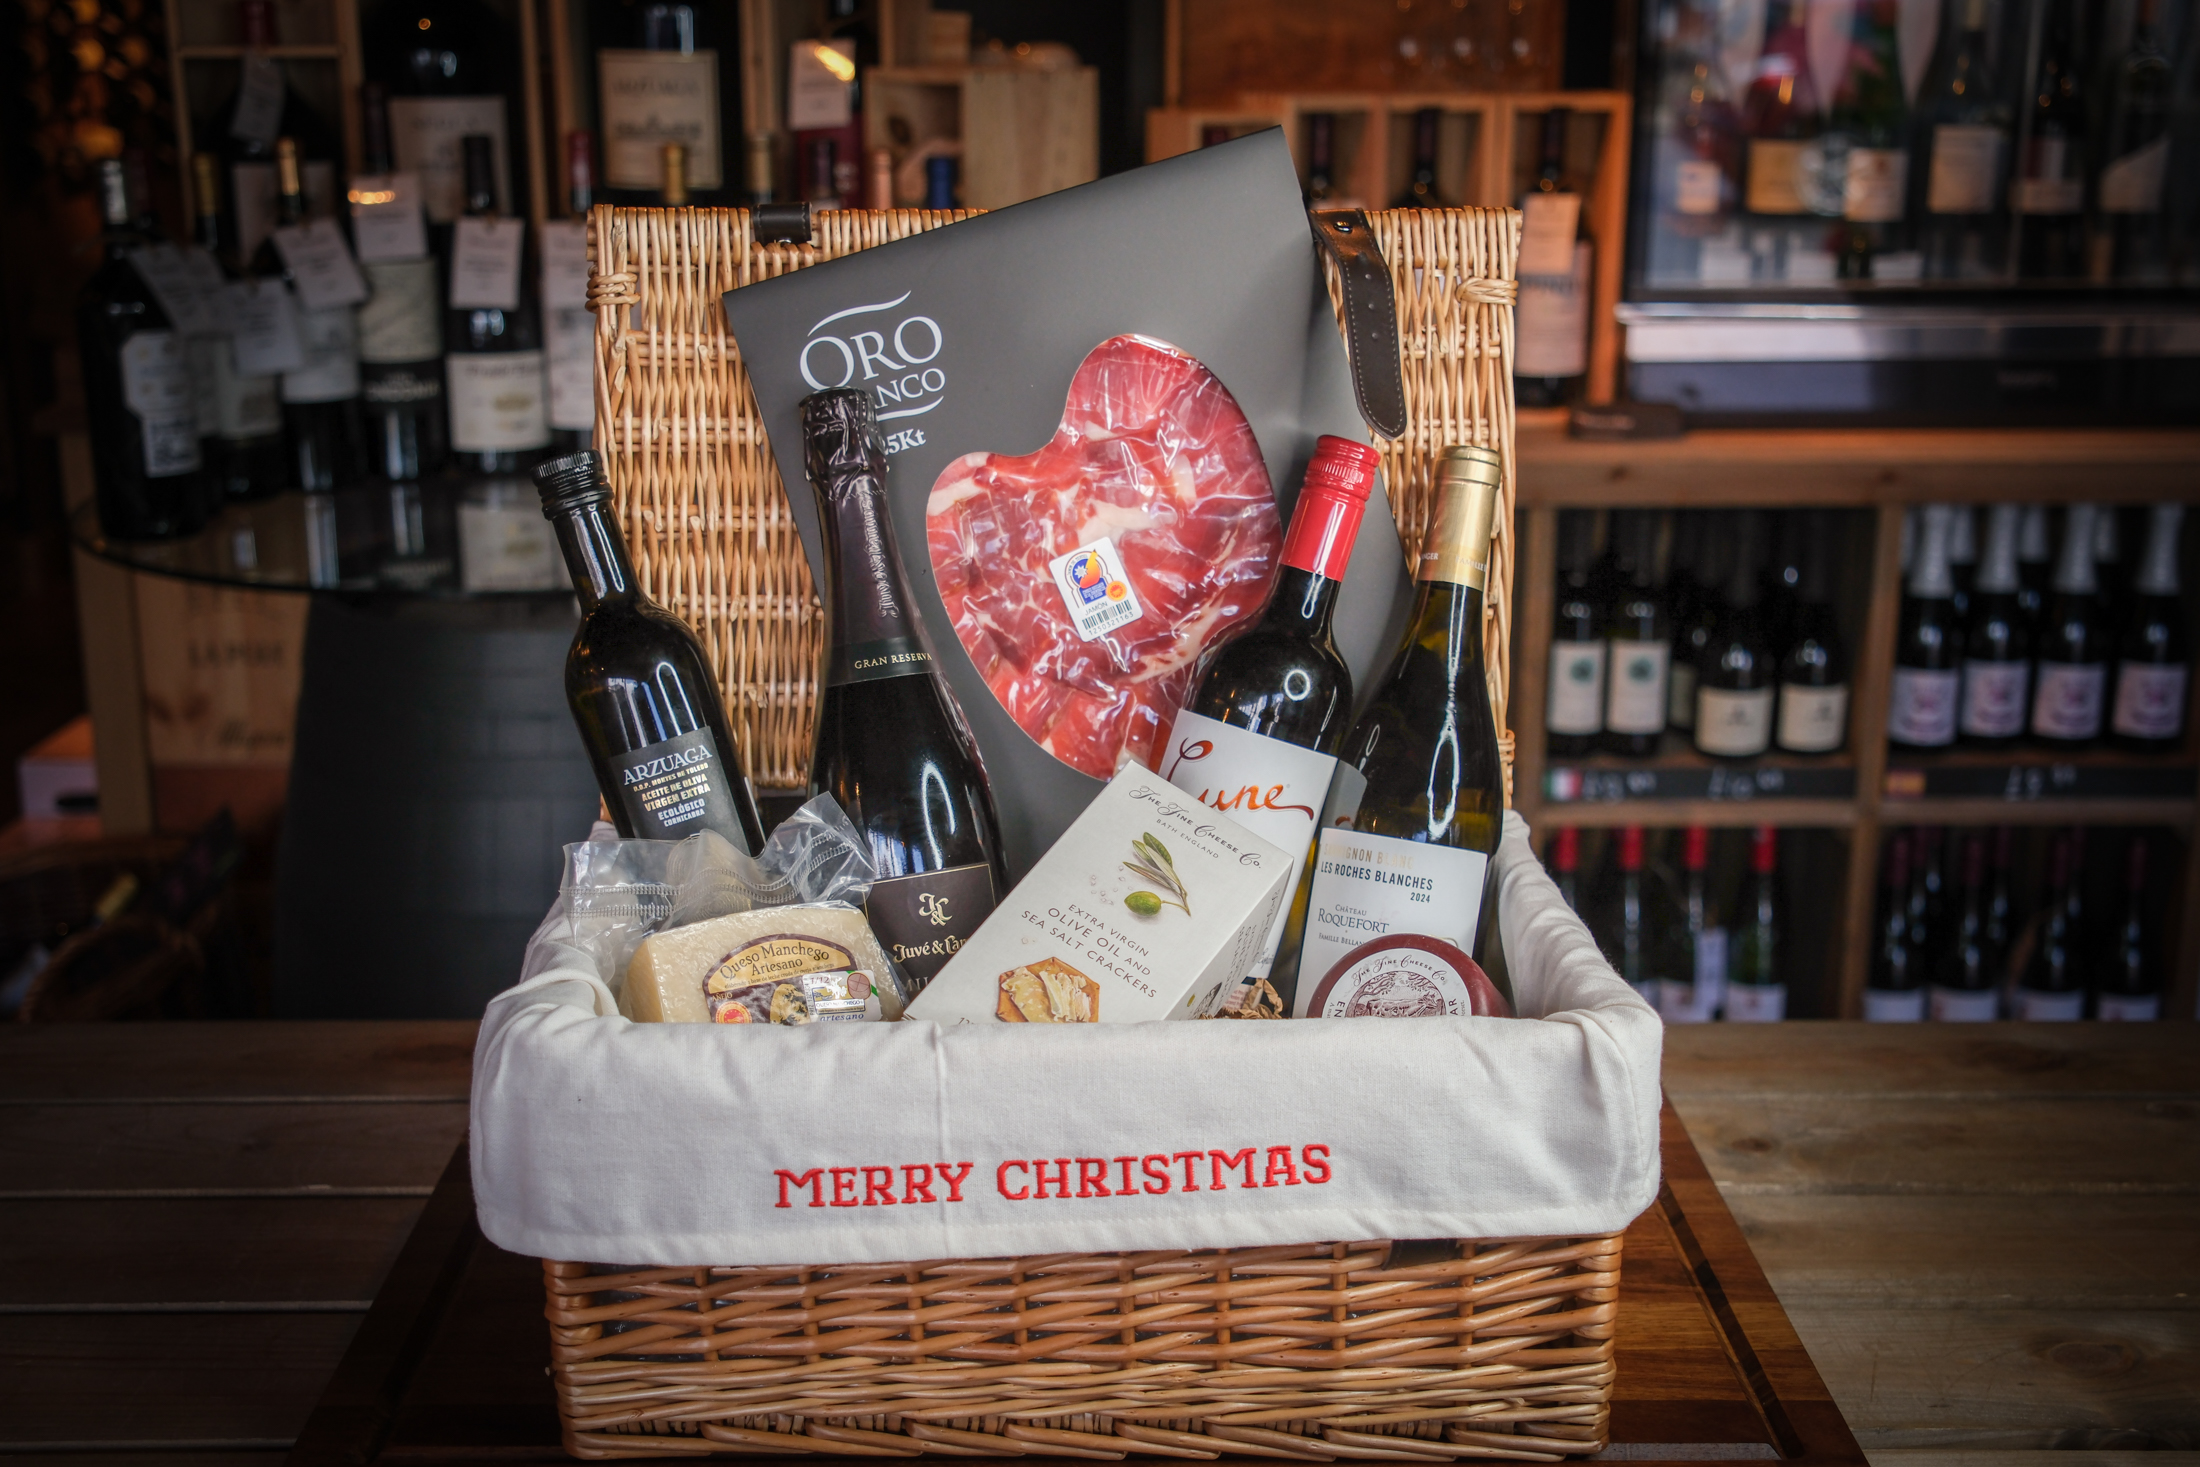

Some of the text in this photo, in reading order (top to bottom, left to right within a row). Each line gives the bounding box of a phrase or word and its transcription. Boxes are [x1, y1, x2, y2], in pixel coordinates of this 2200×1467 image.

[800, 316, 943, 393] ORO
[874, 368, 946, 409] NCO
[885, 428, 926, 455] 5Kt
[1084, 601, 1108, 616] JAMÓN
[1089, 611, 1134, 636] 1250321163
[854, 652, 933, 670] GRAN RESERVA
[624, 745, 713, 786] ARZUAGA
[651, 774, 677, 787] MONTES
[677, 770, 686, 778] DE
[686, 762, 709, 775] TOLEDO
[641, 773, 708, 802] ACEITE DE OLIVA
[644, 783, 711, 812] VIRGEN EXTRA
[657, 798, 706, 821] ECOLÓGICO
[663, 808, 705, 827] CORNICABRA
[1156, 818, 1220, 859] BATH ENGLAND
[1321, 861, 1433, 891] LES ROCHES BLANCHES
[1410, 892, 1431, 903] 2024
[1047, 907, 1152, 977] OLIVE OIL AND
[1068, 903, 1150, 957] EXTRA VIRGIN
[719, 942, 830, 981] Queso Manchego
[892, 941, 931, 963] Juvé
[931, 940, 946, 955] &
[1021, 910, 1158, 998] SEA SALT CRACKERS
[751, 957, 804, 977] Artesano
[820, 1013, 864, 1022] artesano
[774, 1144, 1332, 1209] MERRY CHRISTMAS
